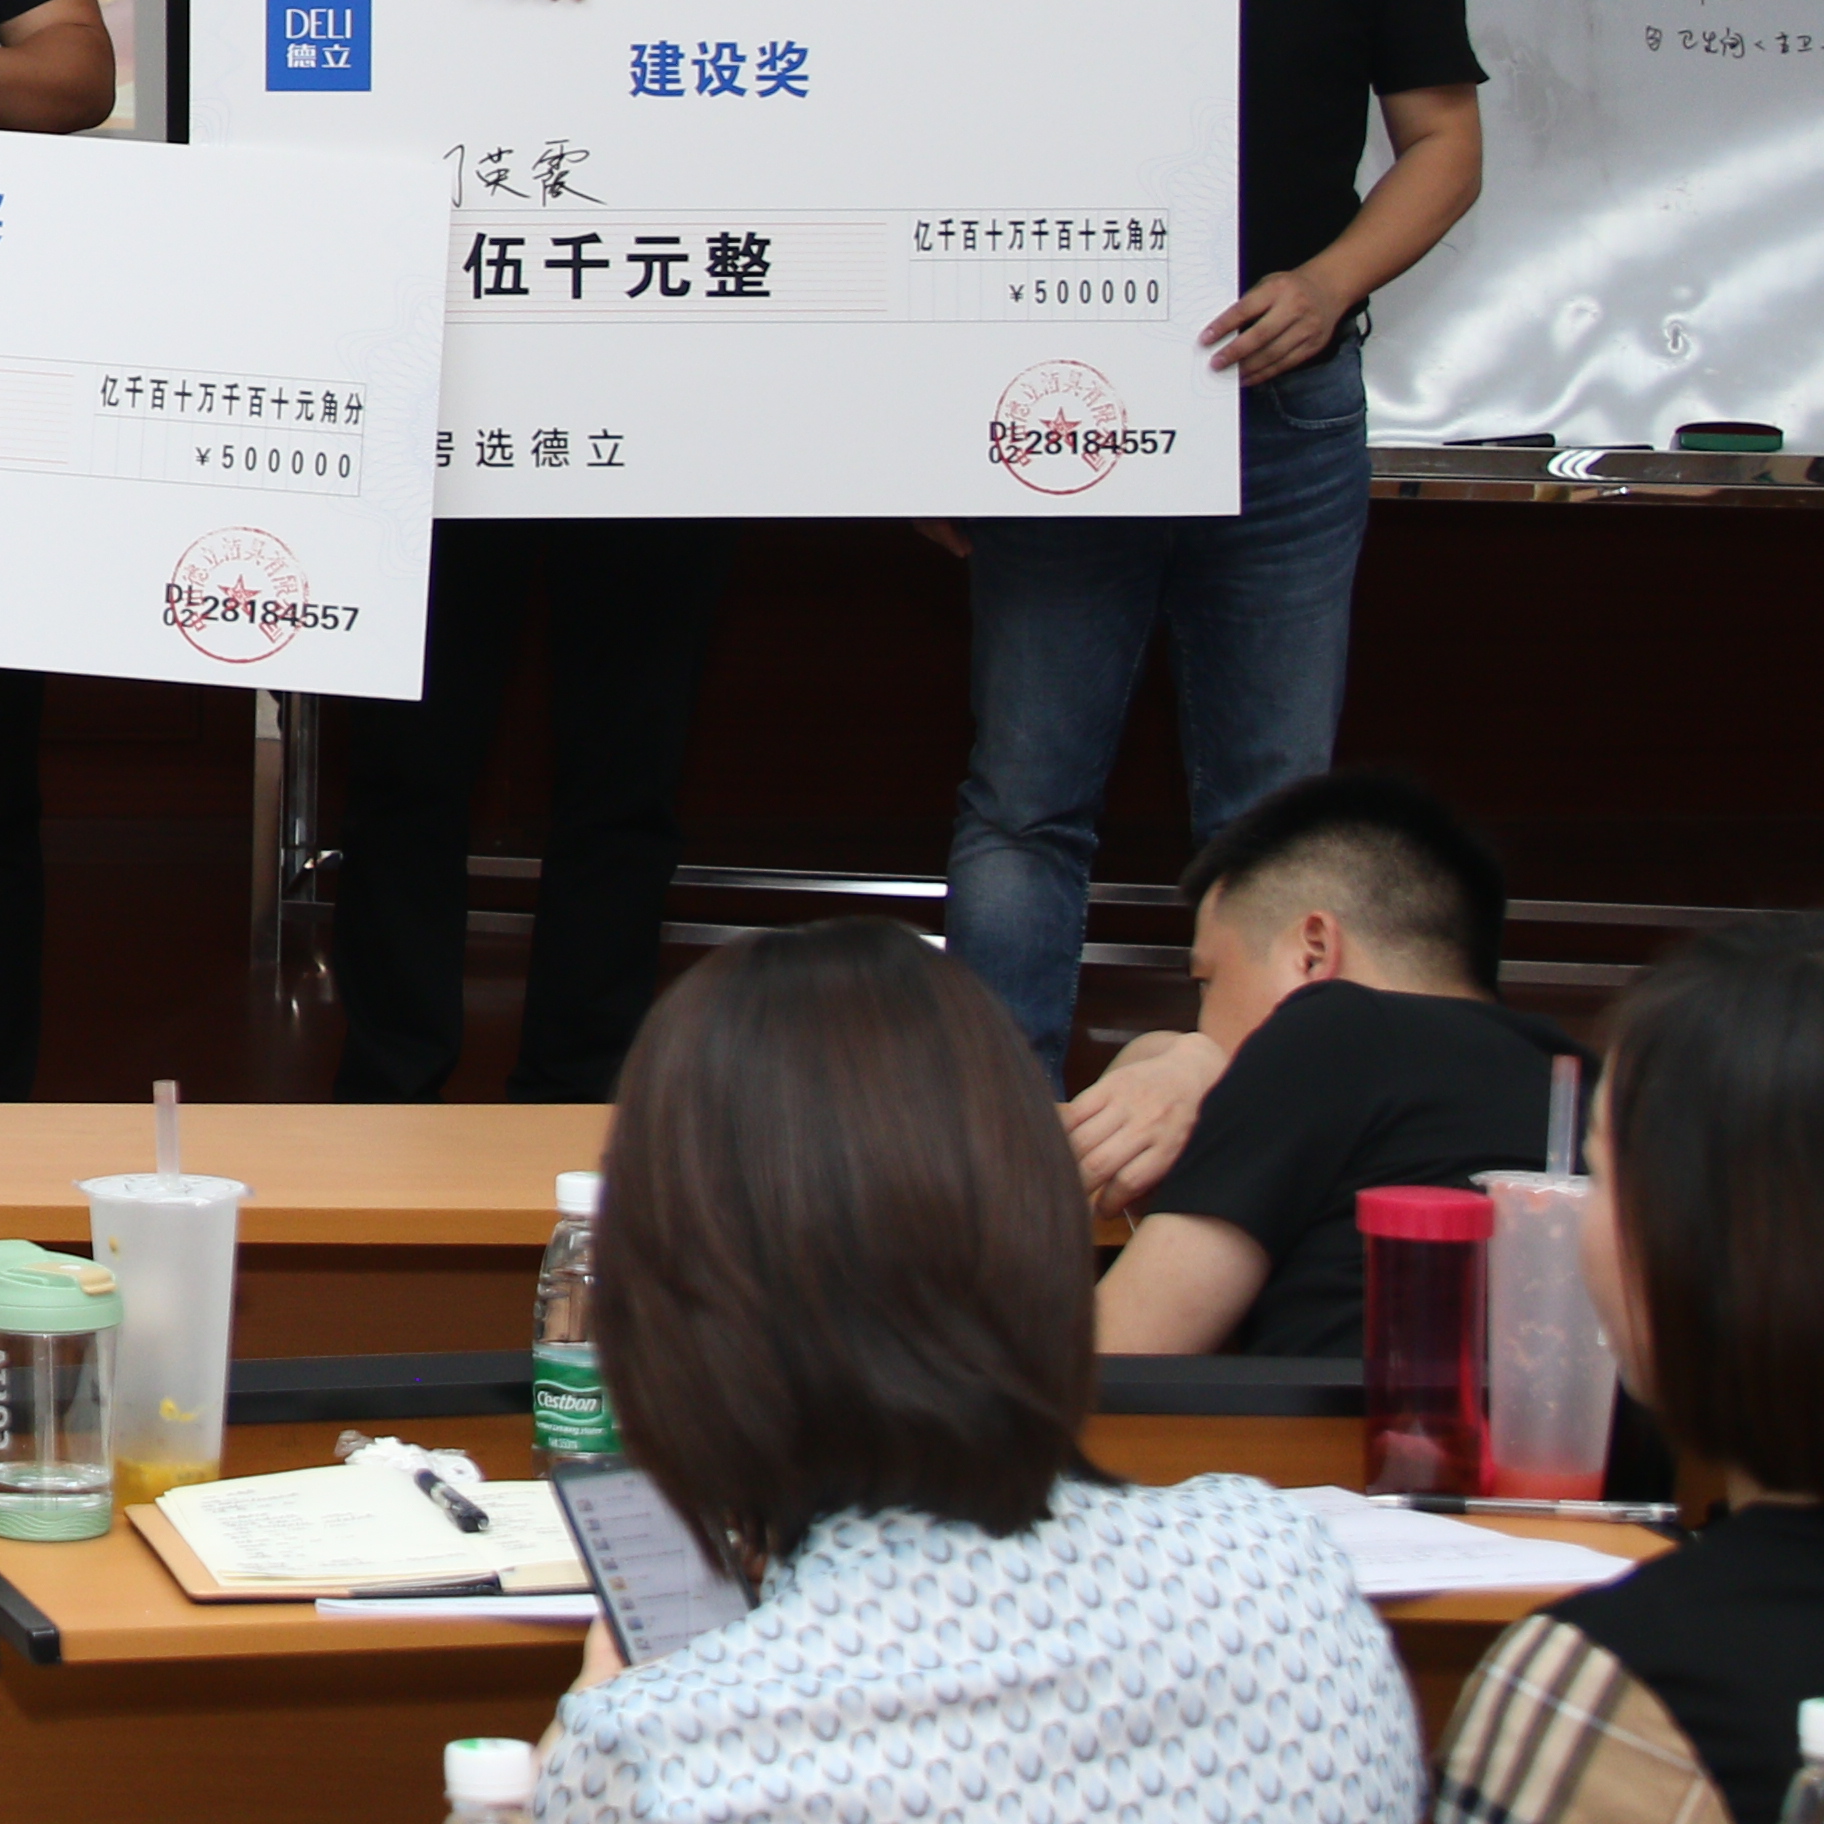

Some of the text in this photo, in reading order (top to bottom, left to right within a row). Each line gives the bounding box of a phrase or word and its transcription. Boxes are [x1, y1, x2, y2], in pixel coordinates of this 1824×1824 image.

[284, 7, 352, 41] DELI
[286, 42, 351, 70] 德立
[628, 40, 810, 100] 建设奖
[464, 232, 773, 301] 伍千元整
[1026, 429, 1177, 455] 28184557
[202, 595, 359, 631] 28184557
